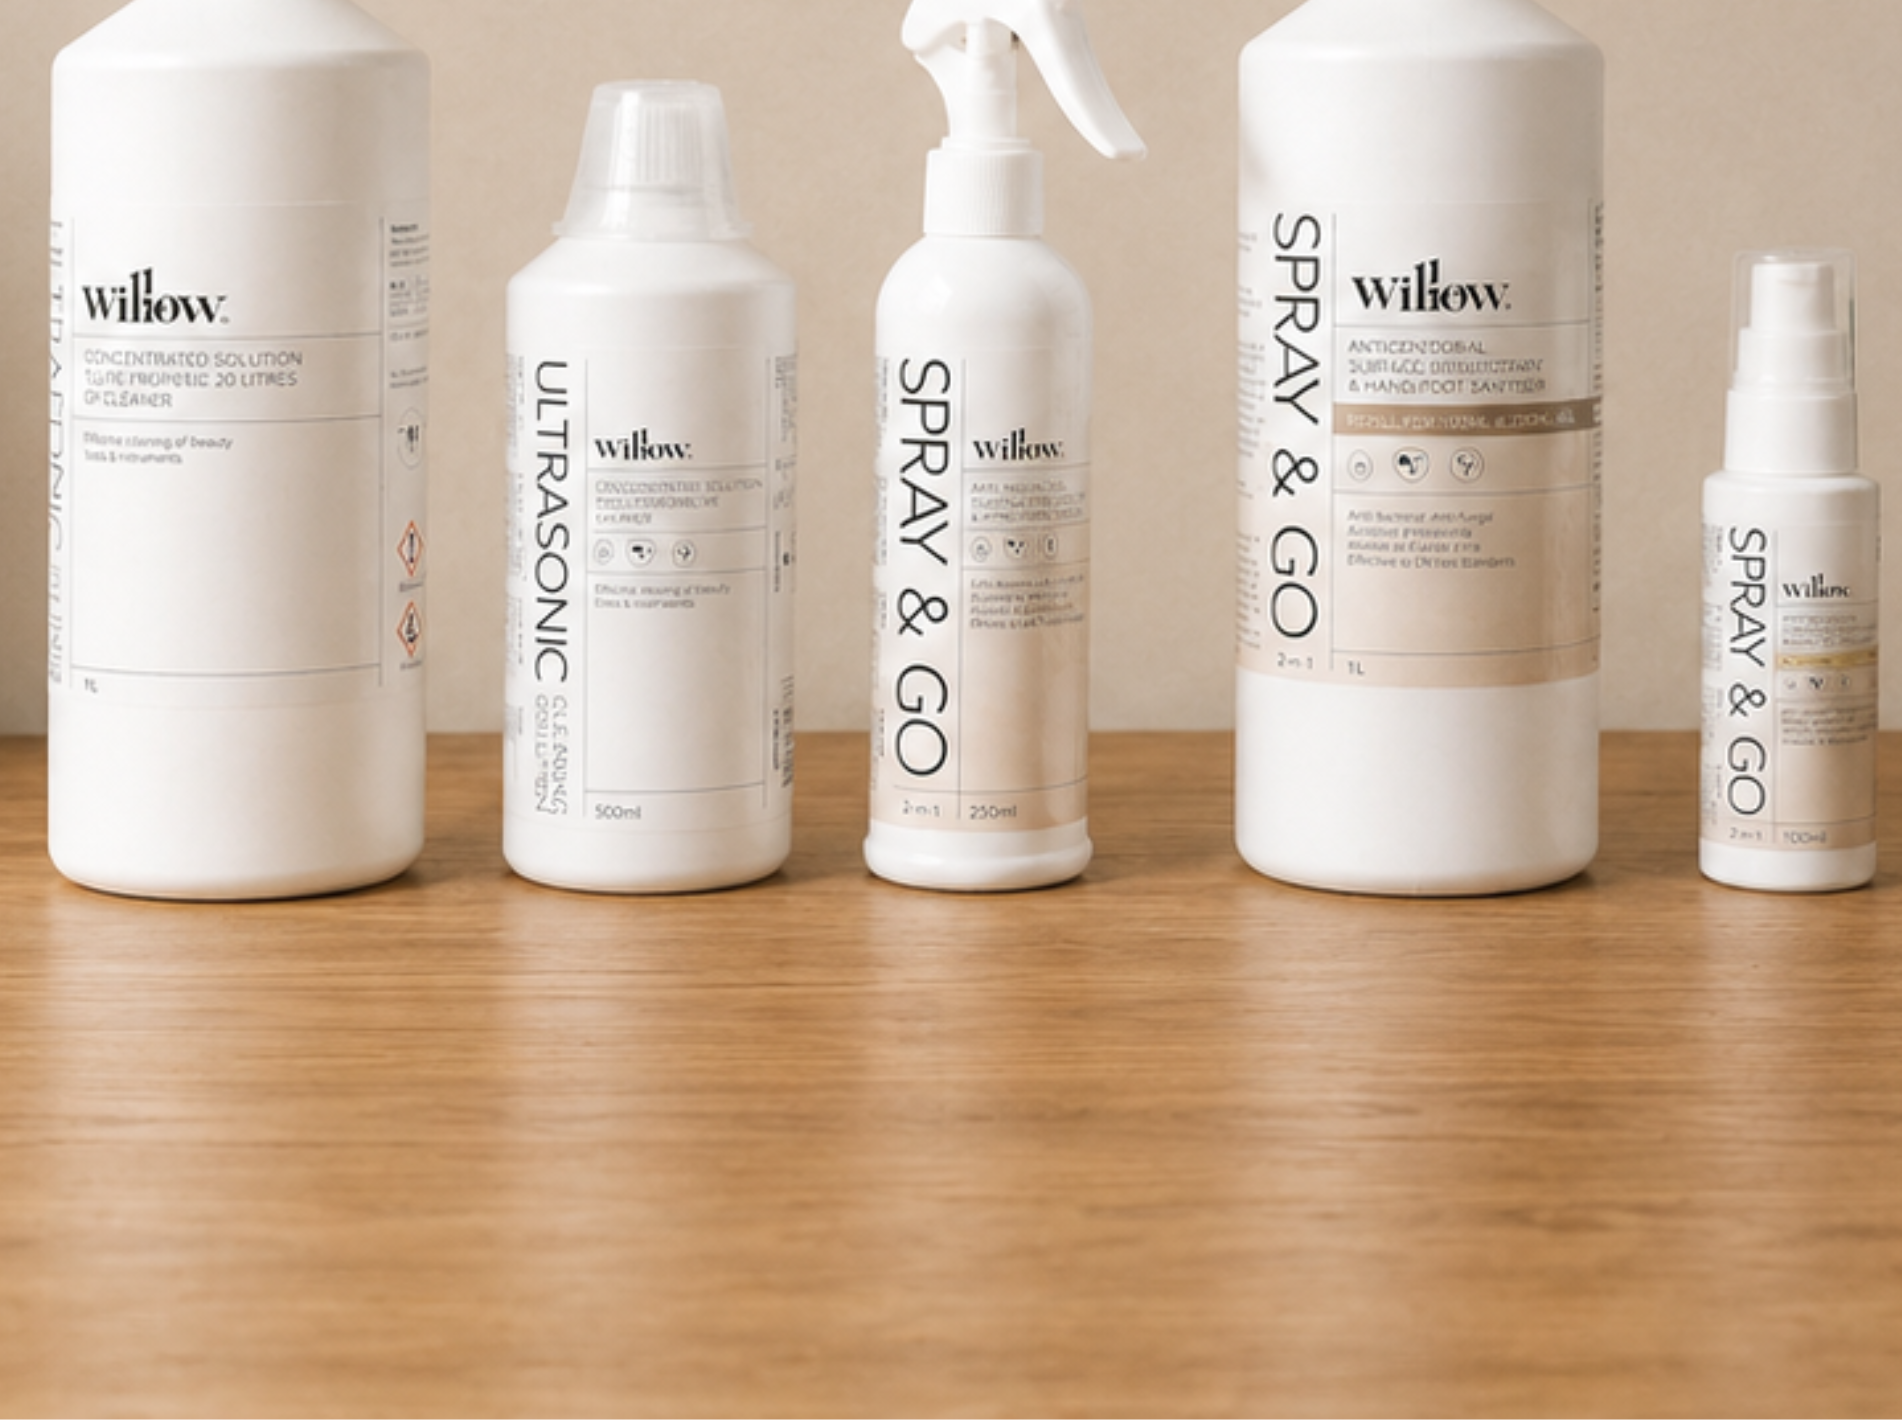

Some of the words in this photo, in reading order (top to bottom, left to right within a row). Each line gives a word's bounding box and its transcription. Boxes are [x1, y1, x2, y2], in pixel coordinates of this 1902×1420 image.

[1271, 212, 1322, 425] SPRAY
[897, 357, 952, 567] SPRAY
[1271, 448, 1320, 498] &
[533, 360, 571, 684] ULTRASONIC
[896, 587, 950, 637] &
[1270, 525, 1319, 640] GO
[1729, 526, 1768, 668] SPRAY
[894, 663, 949, 778] GO
[1728, 682, 1768, 717] &
[595, 803, 642, 820] 500ml
[970, 804, 1018, 820] 250ml
[1727, 735, 1767, 816] GO
